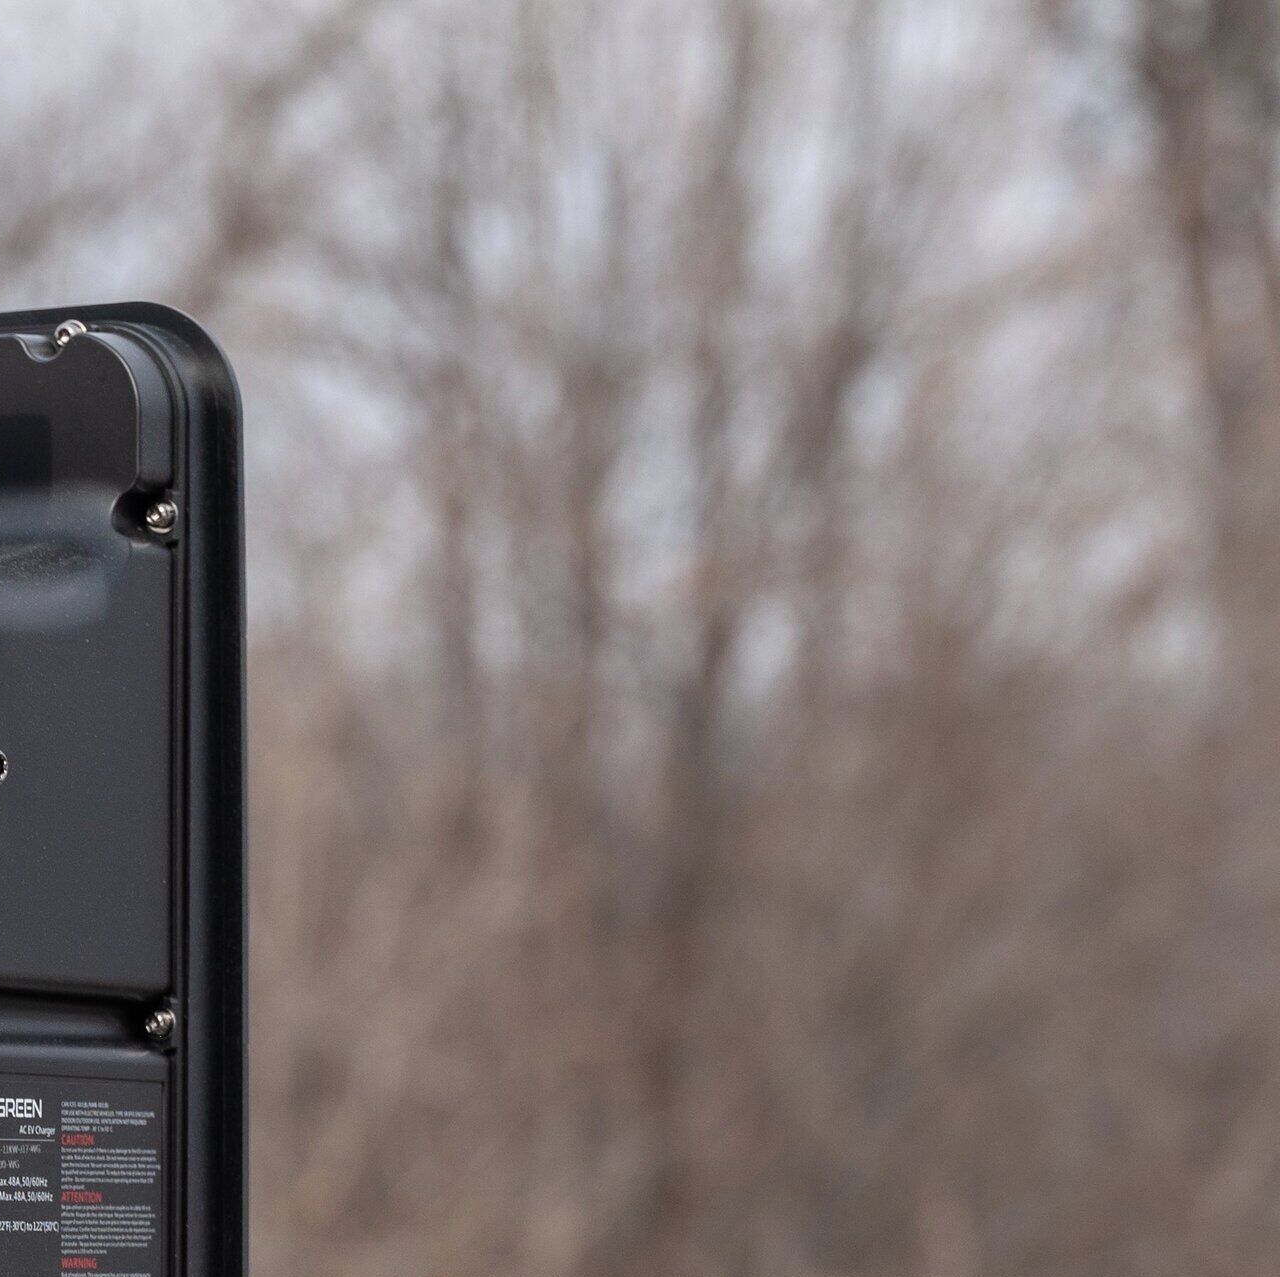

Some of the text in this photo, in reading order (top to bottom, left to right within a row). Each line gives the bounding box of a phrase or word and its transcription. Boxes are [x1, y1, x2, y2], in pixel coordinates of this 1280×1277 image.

[19, 1125, 27, 1134] AC
[27, 1125, 35, 1135] EV
[35, 1125, 56, 1138] Charger
[26, 1221, 33, 1231] to
